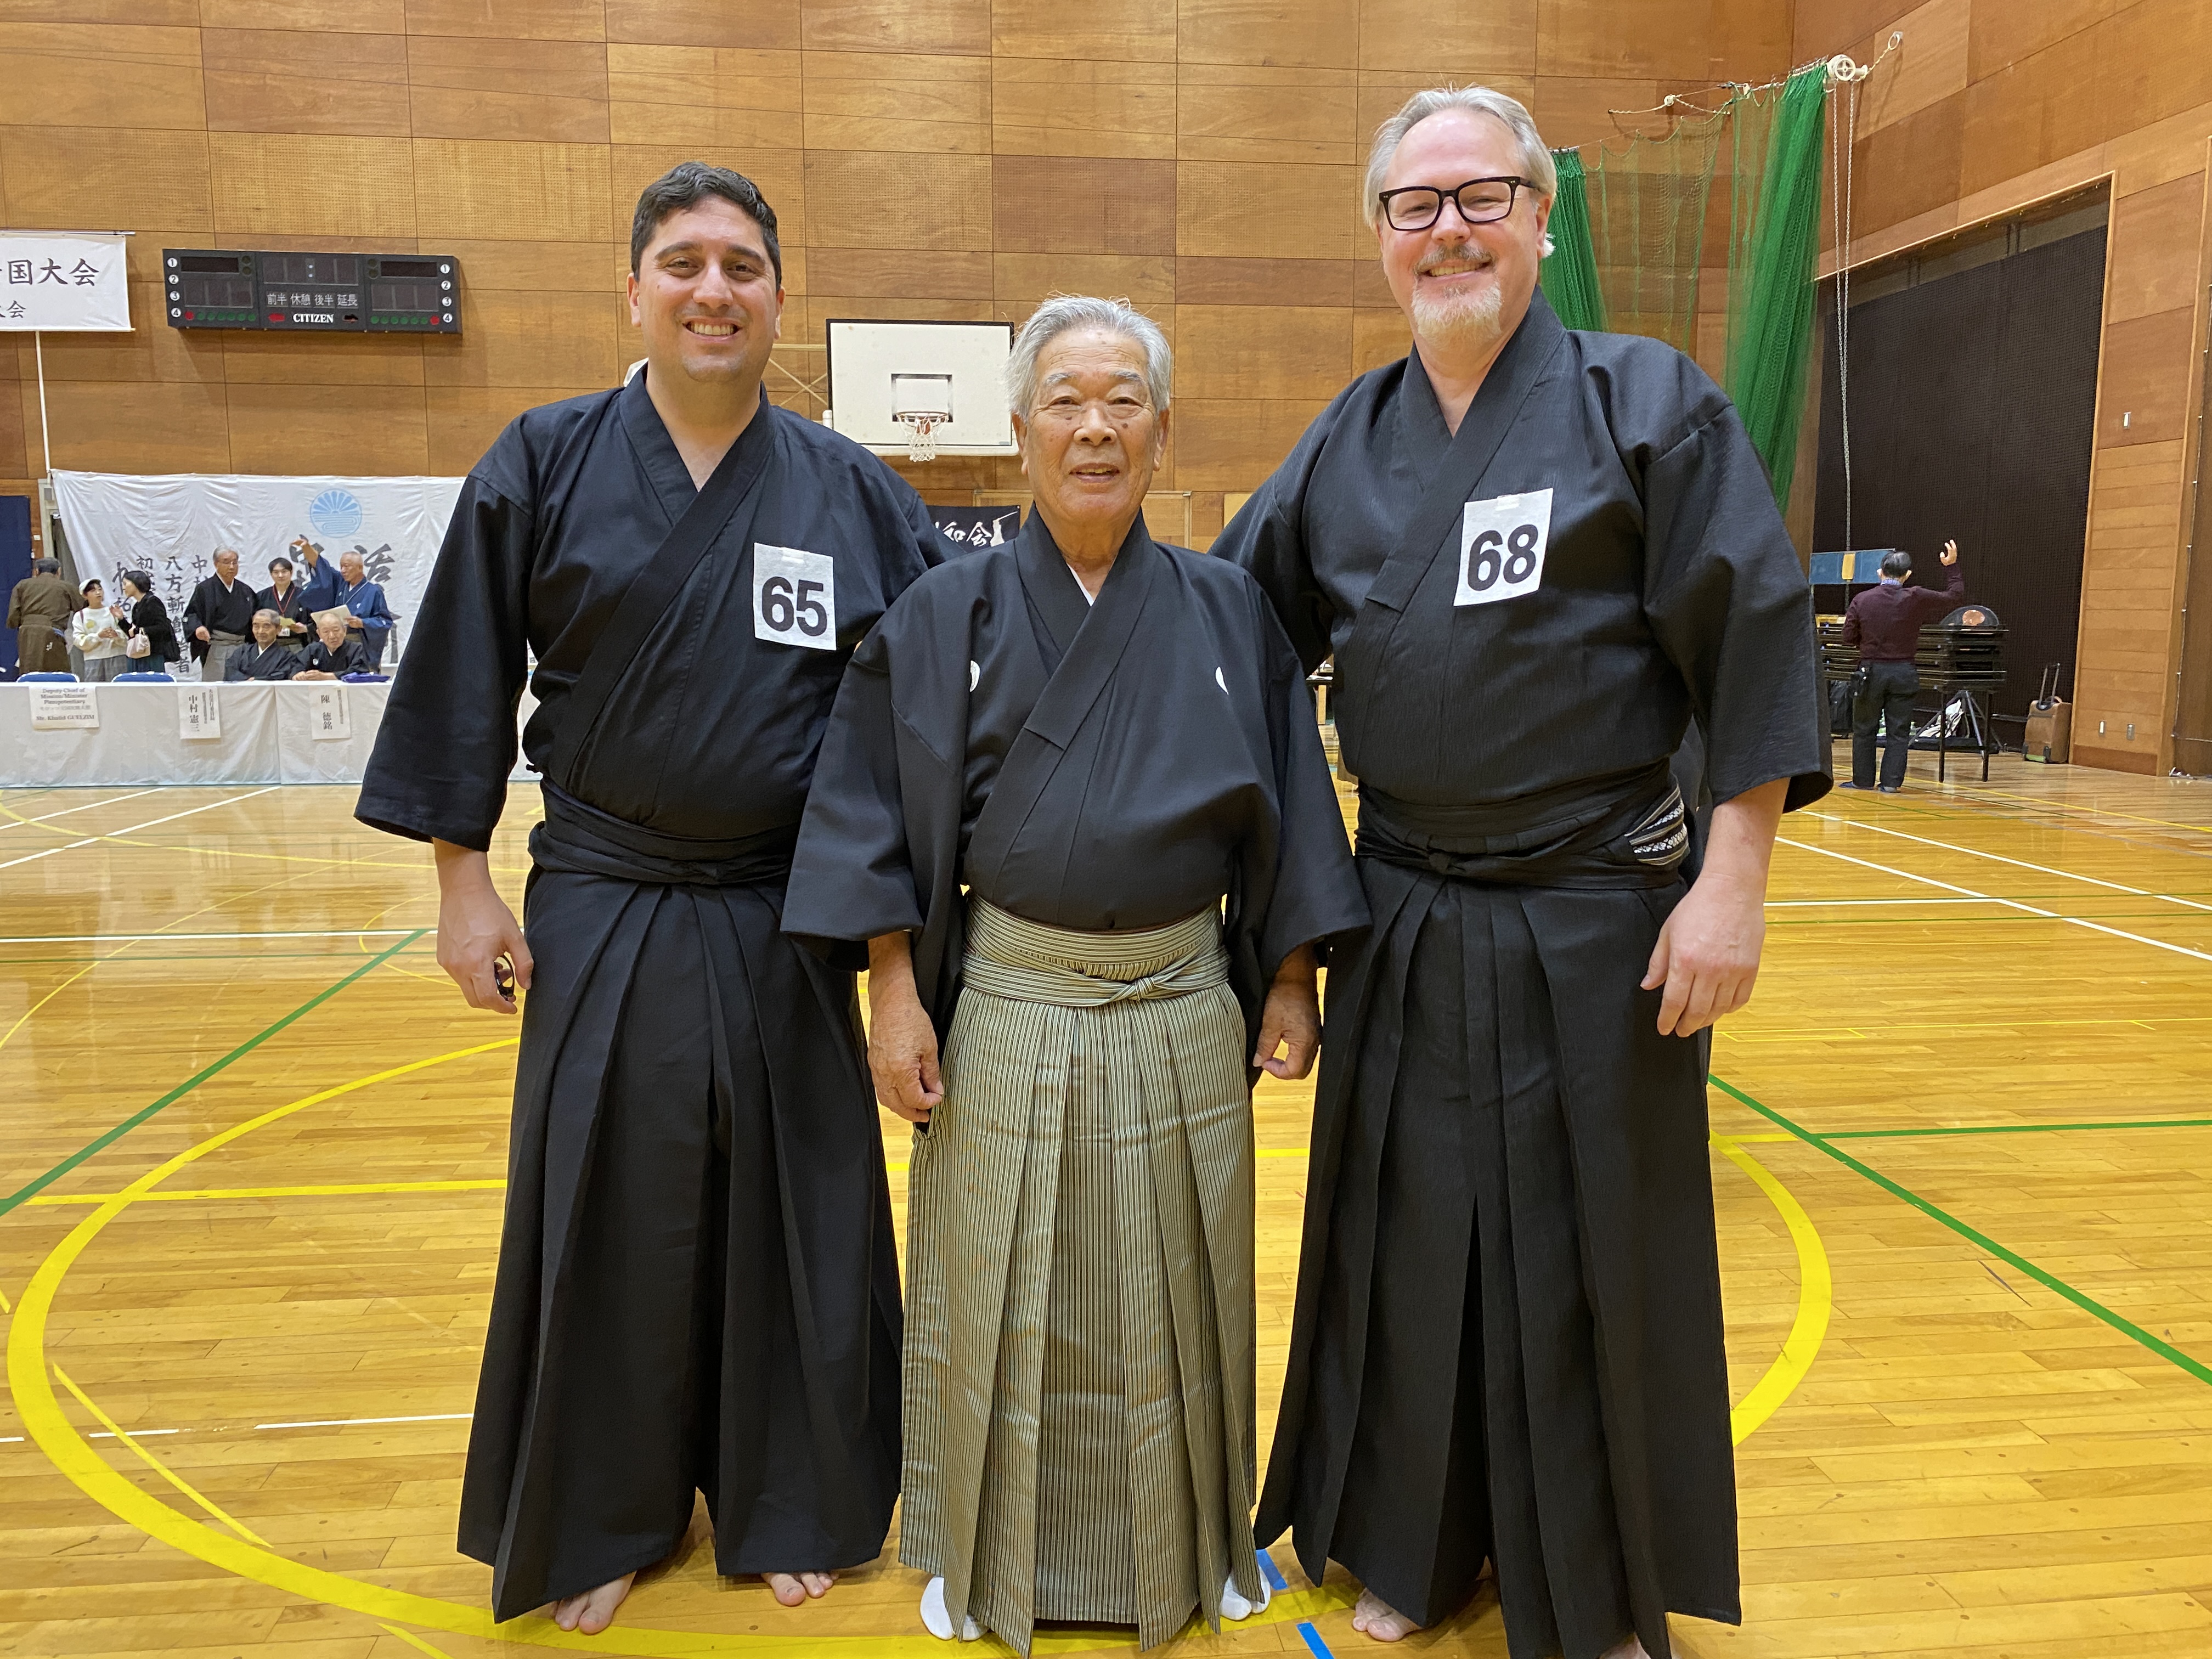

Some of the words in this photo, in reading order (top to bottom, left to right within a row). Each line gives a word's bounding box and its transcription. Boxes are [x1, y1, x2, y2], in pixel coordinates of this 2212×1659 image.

[0, 258, 99, 286] 国大会
[267, 293, 287, 306] 前半
[290, 293, 311, 306] 休憩
[314, 294, 334, 306] 後半
[337, 294, 358, 306] 延長
[293, 313, 334, 323] CITIZEN
[1468, 524, 1538, 591] 68
[762, 576, 827, 636] 65
